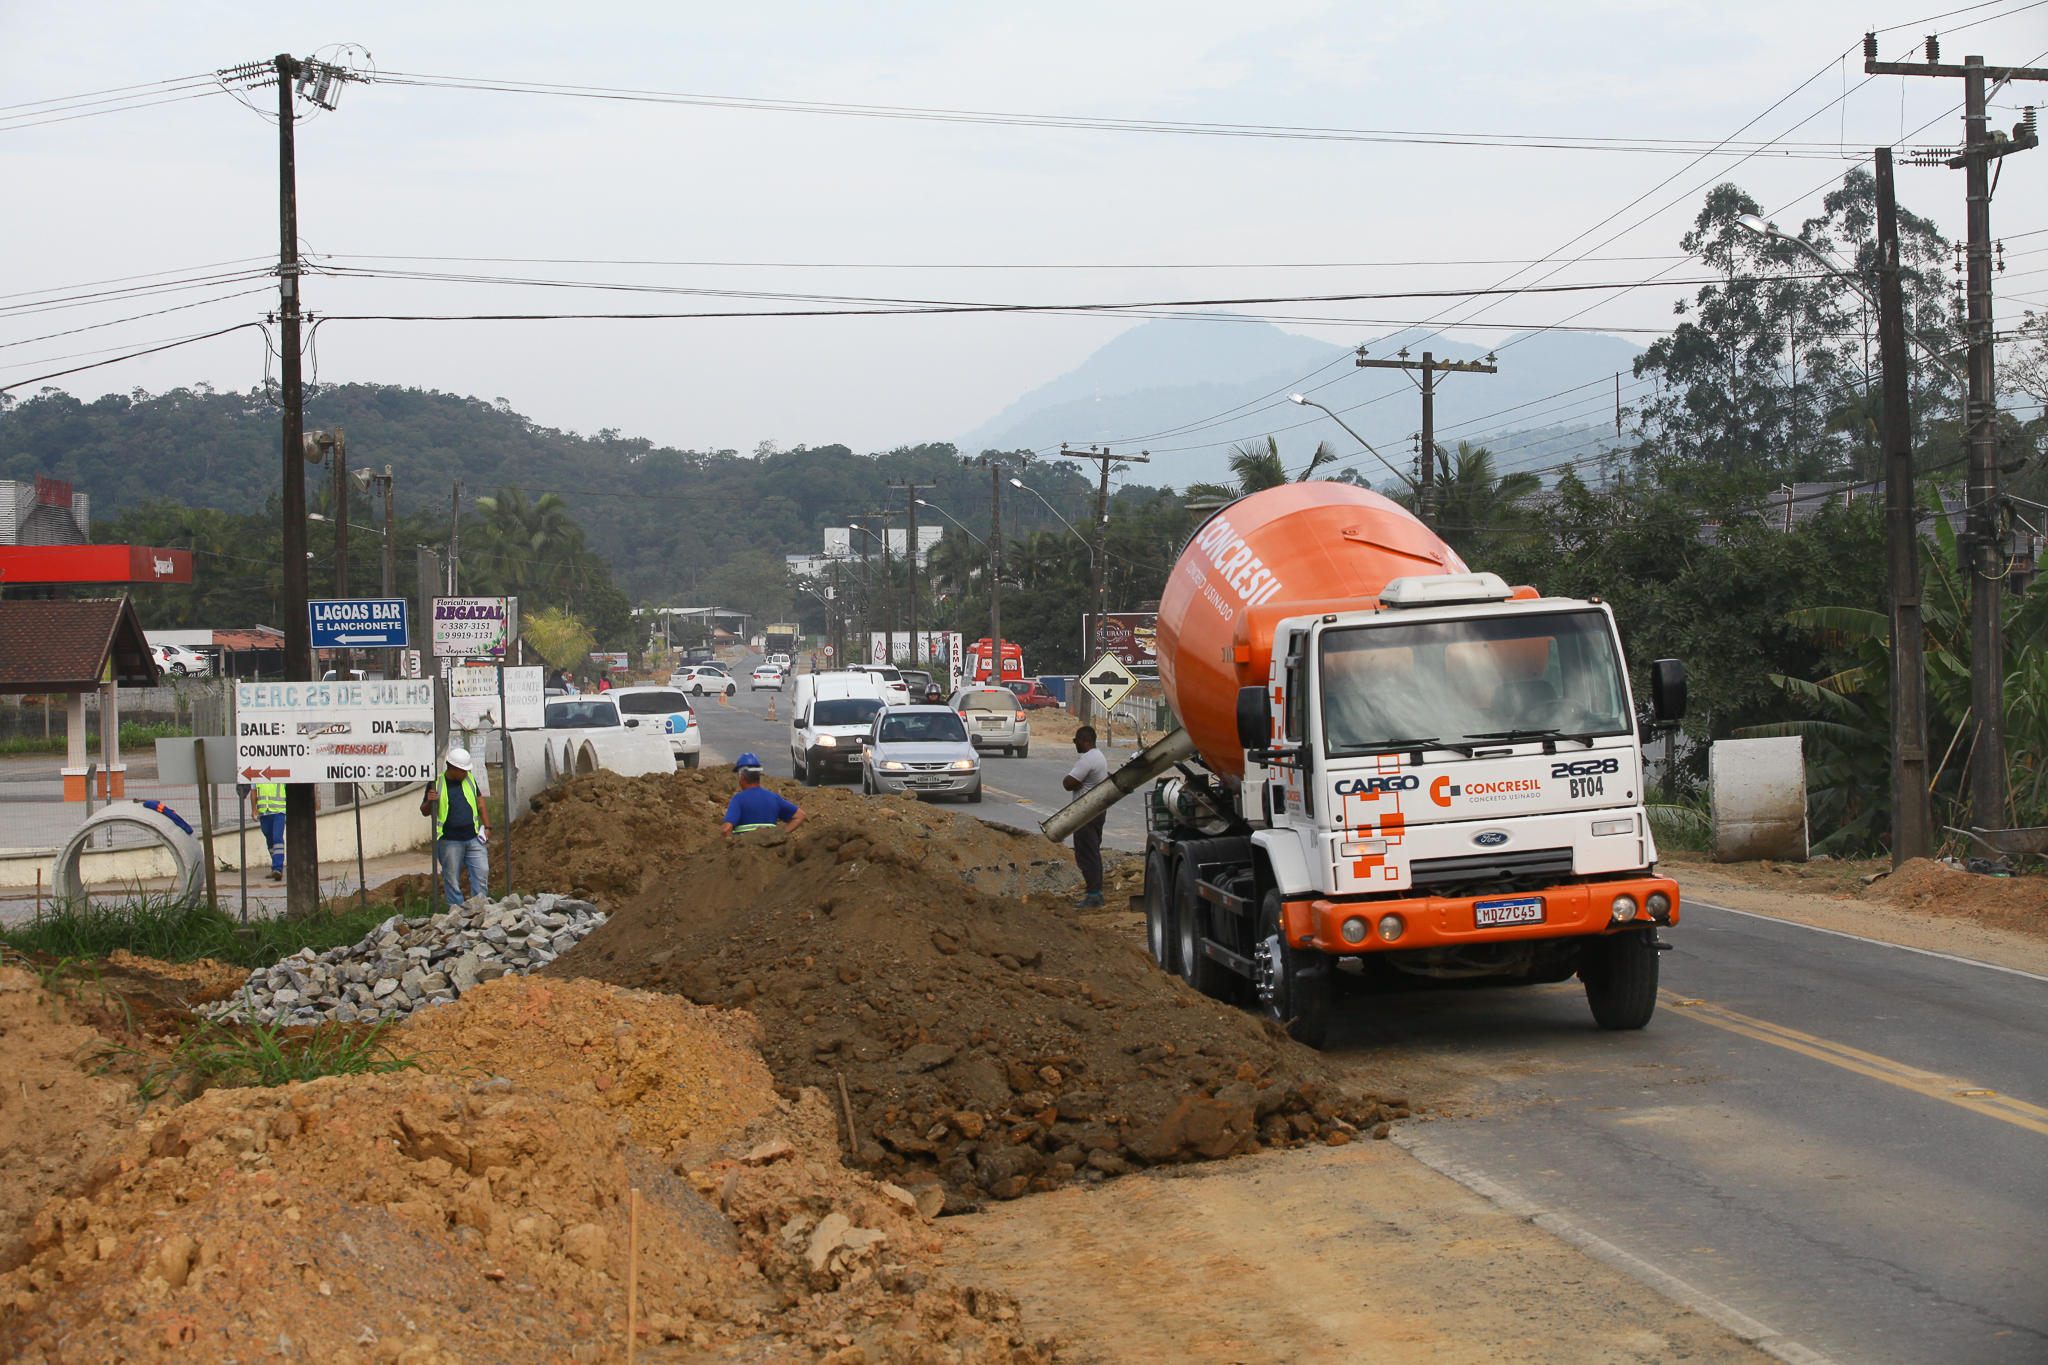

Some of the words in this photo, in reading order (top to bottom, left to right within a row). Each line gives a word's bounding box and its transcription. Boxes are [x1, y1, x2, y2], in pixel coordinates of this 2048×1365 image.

[1185, 560, 1207, 589] CONCRETO
[1203, 583, 1234, 621] USINADO
[315, 604, 369, 620] LAGOAS
[372, 603, 401, 619] BAR
[435, 606, 504, 620] REGATAL
[316, 623, 324, 631] E
[326, 622, 402, 631] LANCHONETE
[448, 622, 490, 630] 3387-3151
[506, 682, 540, 692] MIRANTE
[239, 686, 301, 707] S.E.R.C.
[306, 685, 331, 706] 25
[337, 684, 362, 705] DE
[369, 683, 431, 705] JULHO
[506, 695, 538, 706] ARROSO
[240, 722, 285, 736] BAILE:
[372, 720, 399, 734] DIA:
[240, 744, 310, 757] CONJUNTO:
[335, 744, 388, 755] MENSAGEM
[326, 763, 370, 779] INÍCIO:
[375, 765, 417, 778] 22:00
[420, 764, 430, 778] H
[1334, 775, 1420, 795] CARGO
[1465, 779, 1541, 795] CONCRESIL
[1550, 758, 1619, 779] 2628
[1569, 776, 1604, 799] BT04
[1469, 794, 1507, 803] CONCRETO
[1509, 792, 1541, 801] USINADO
[1480, 832, 1502, 844] Ford
[1482, 905, 1536, 922] MDZ7C45
